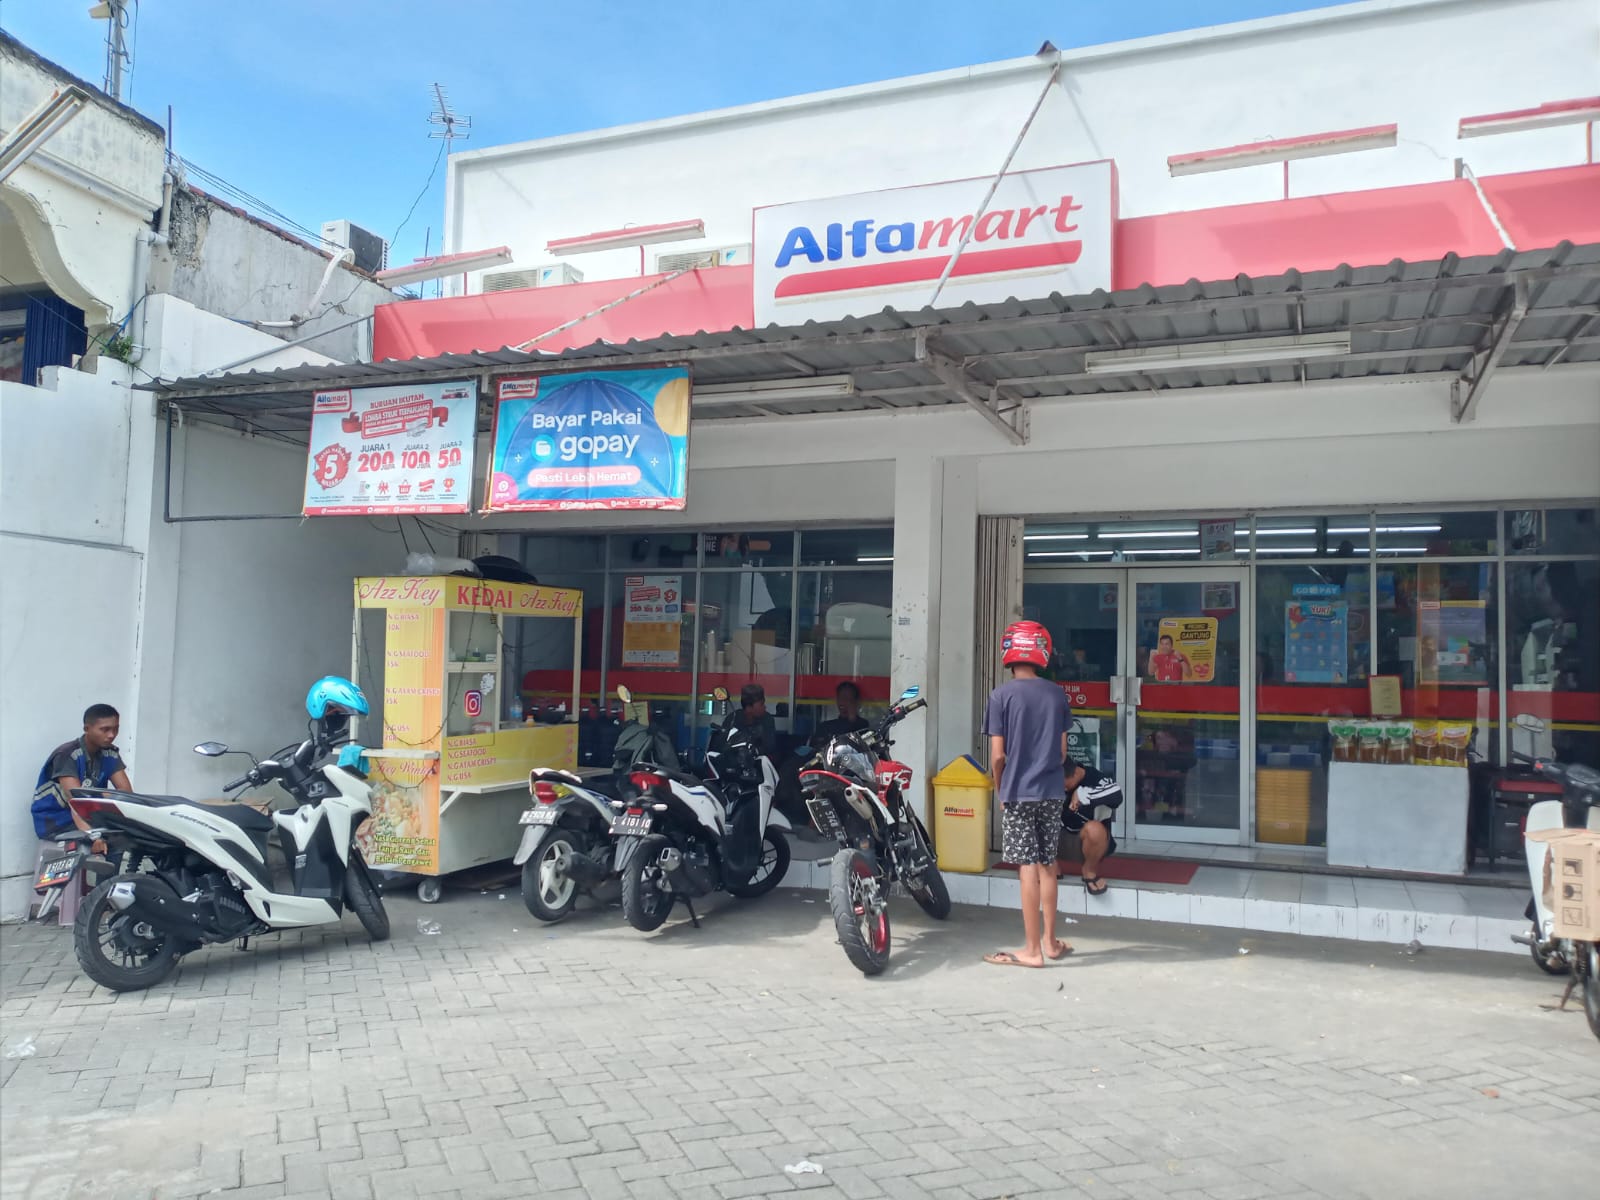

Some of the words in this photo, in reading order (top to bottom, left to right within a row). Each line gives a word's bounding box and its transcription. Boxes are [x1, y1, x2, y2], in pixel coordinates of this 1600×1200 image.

[774, 195, 1083, 268] Alfamart
[532, 411, 586, 432] Bayar
[591, 407, 643, 426] Pakai
[360, 444, 386, 453] JUARA
[404, 444, 424, 452] JUARA
[437, 447, 461, 469] 50
[559, 433, 641, 461] gopay
[323, 454, 339, 479] 5
[357, 450, 395, 473] 200
[400, 450, 431, 469] 100
[535, 470, 563, 483] Pasti
[596, 469, 633, 482] Hemat
[457, 584, 514, 608] KEDAI
